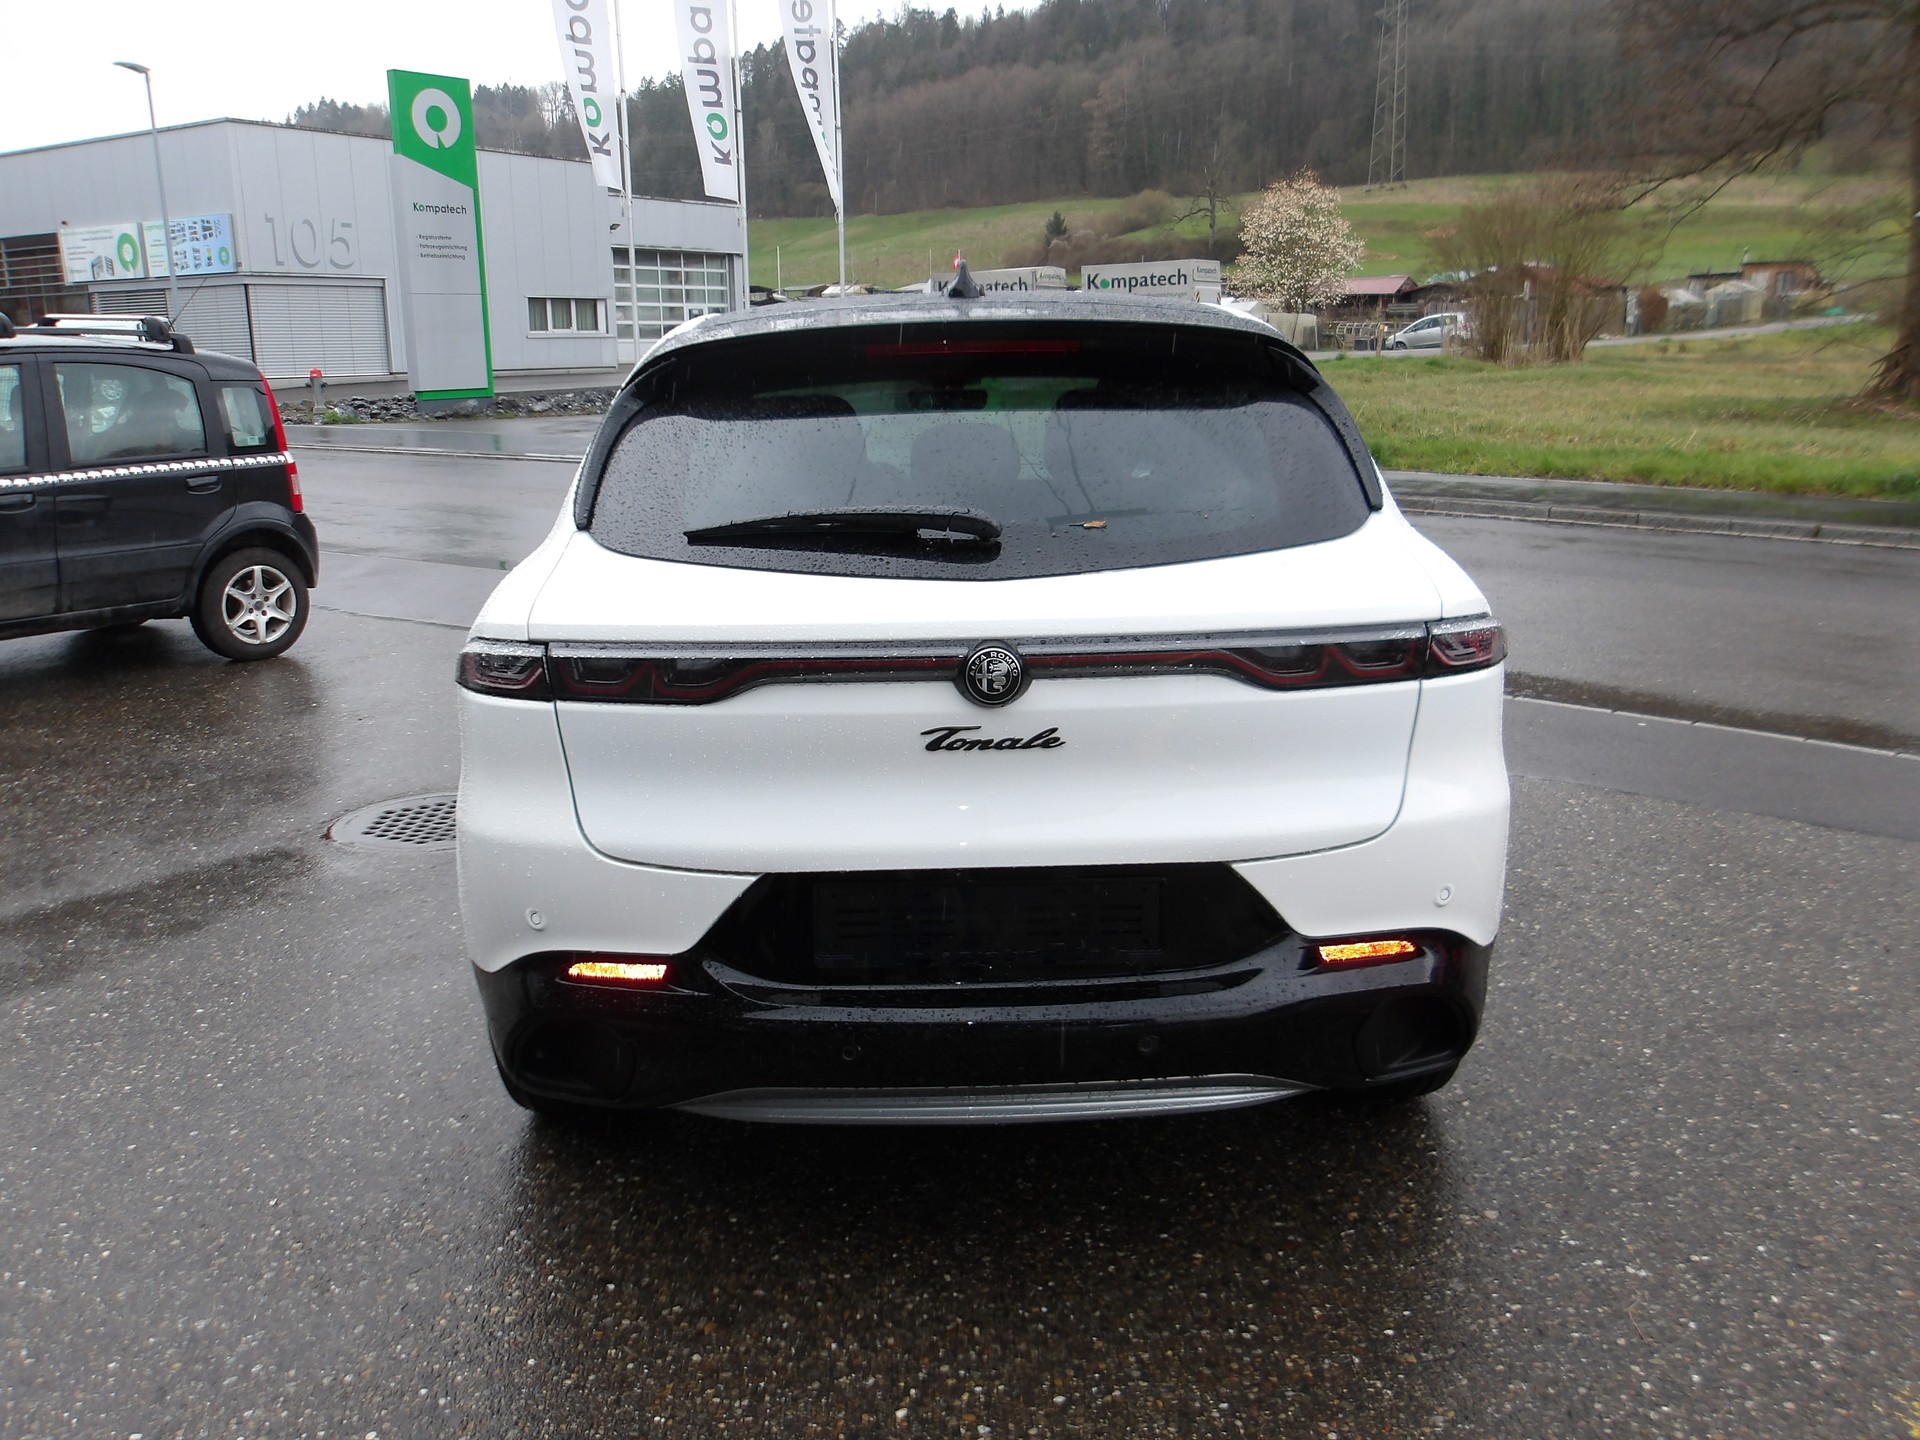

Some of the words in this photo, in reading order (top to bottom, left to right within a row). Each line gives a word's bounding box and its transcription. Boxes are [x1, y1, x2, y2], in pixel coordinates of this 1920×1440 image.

[413, 202, 467, 215] Kompatech
[265, 213, 355, 270] 105
[420, 243, 468, 251] Fahrzeugeinrichtung
[421, 252, 466, 260] Betriebseinrichtung
[938, 277, 1028, 292] Katech
[1087, 268, 1188, 293] Kompatech
[970, 654, 987, 677] ALFA
[990, 651, 1018, 677] ROMEO
[920, 725, 1066, 751] Tonale
